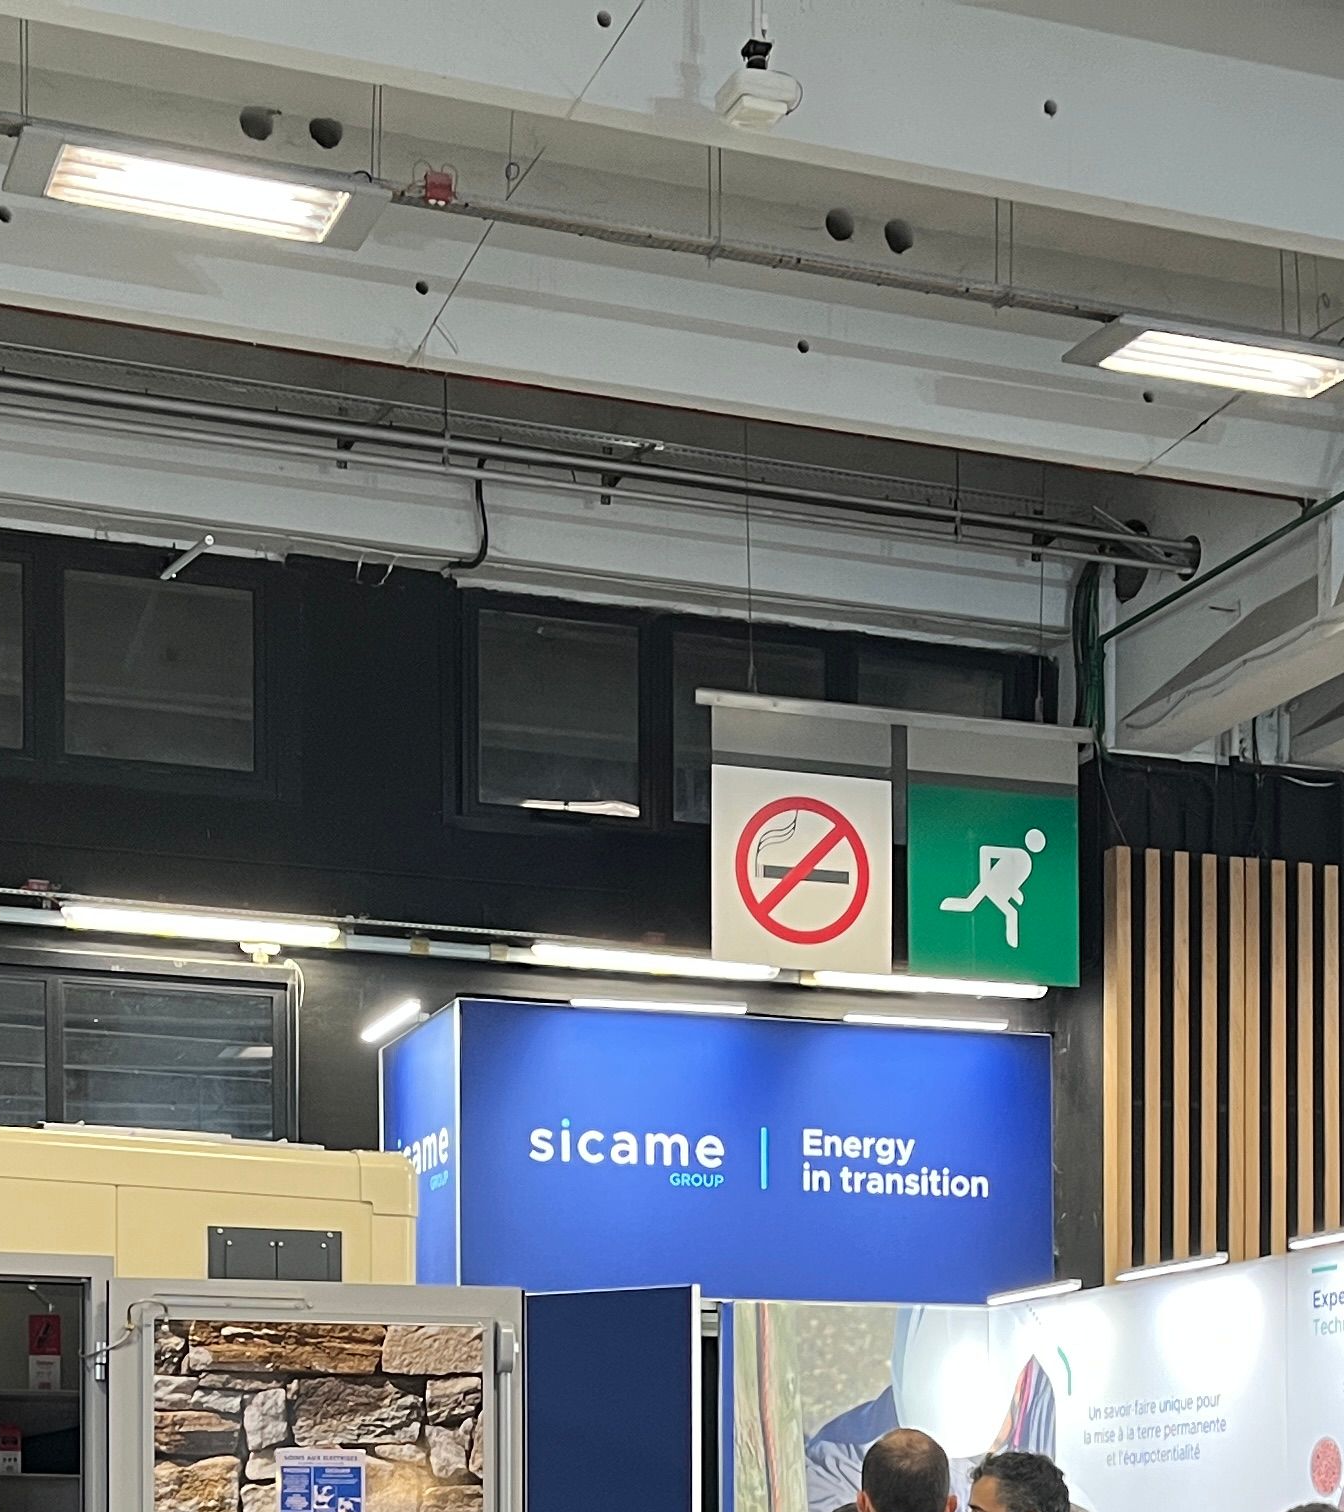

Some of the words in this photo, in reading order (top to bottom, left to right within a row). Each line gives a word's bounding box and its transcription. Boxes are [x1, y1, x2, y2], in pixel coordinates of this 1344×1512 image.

[529, 1118, 725, 1169] sicame
[803, 1128, 916, 1166] Energy
[669, 1172, 724, 1188] GROUP
[803, 1161, 831, 1192] in
[840, 1166, 990, 1198] transition
[1088, 1406, 1102, 1421] Un
[1159, 1395, 1193, 1414] unique
[1196, 1393, 1222, 1412] pour
[1137, 1425, 1161, 1440] terre
[1163, 1417, 1227, 1440] permanente
